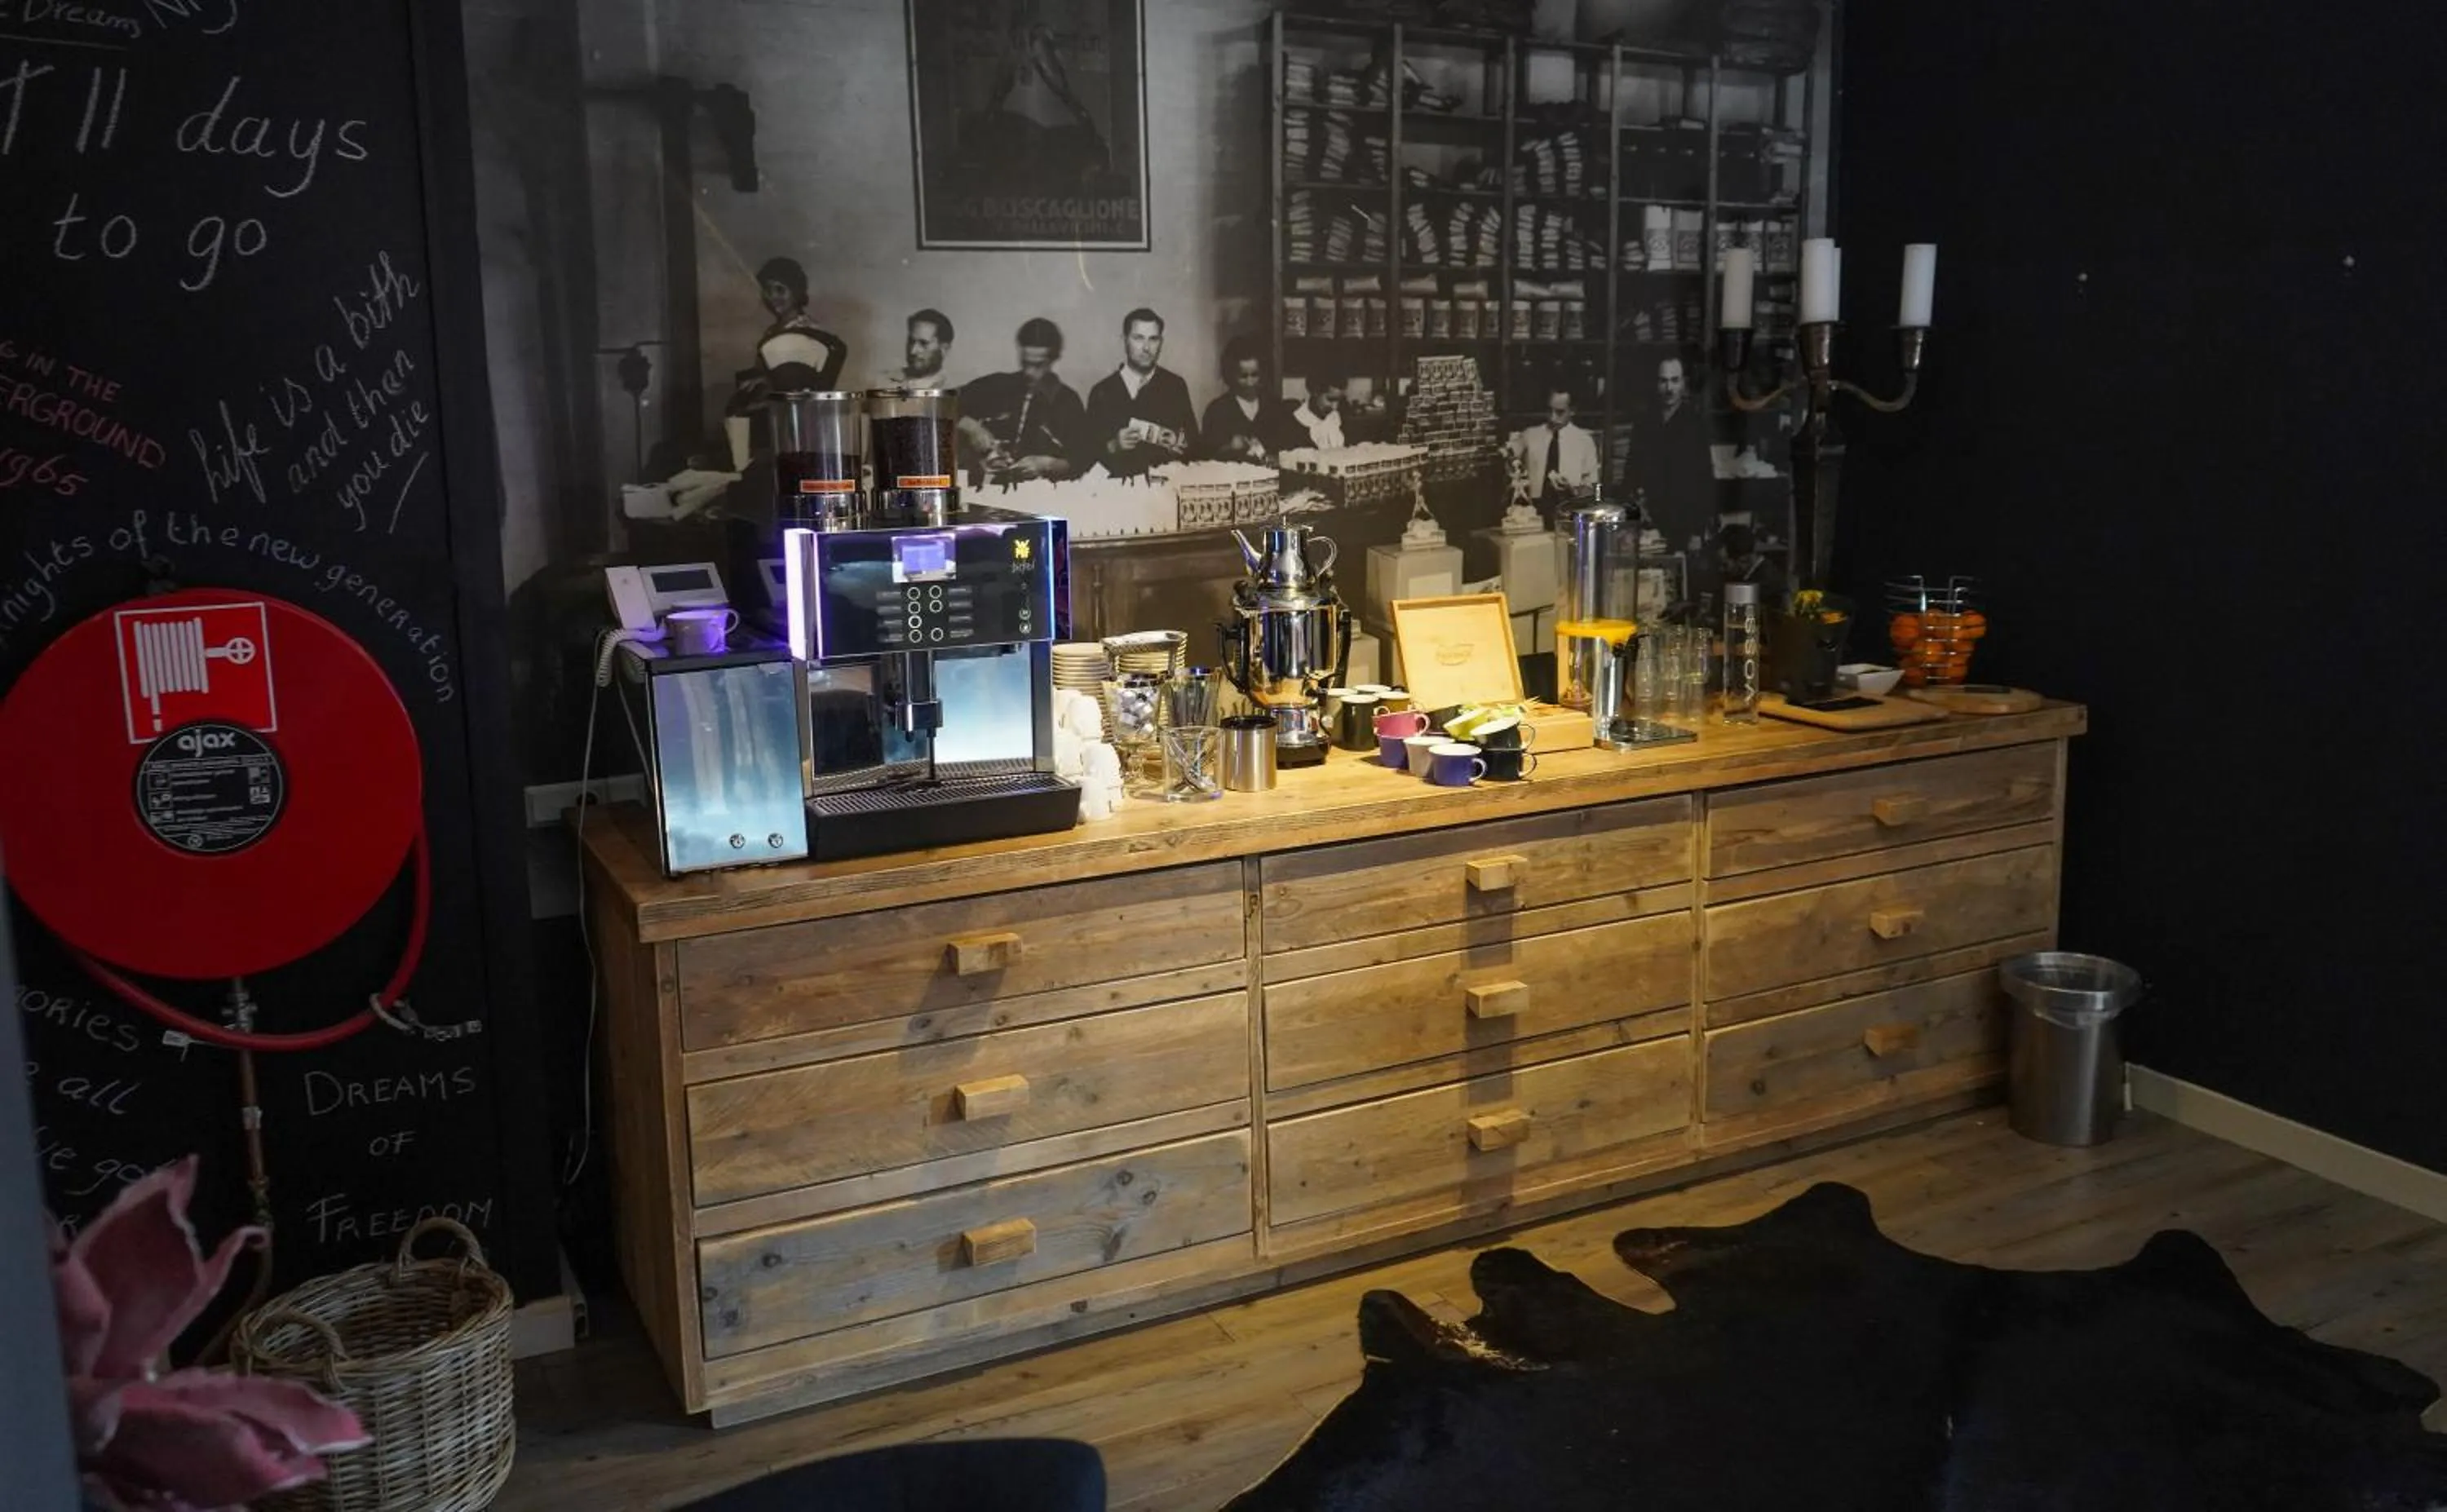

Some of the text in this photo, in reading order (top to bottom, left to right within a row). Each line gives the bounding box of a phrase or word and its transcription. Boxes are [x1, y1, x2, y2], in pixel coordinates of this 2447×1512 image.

[176, 75, 369, 198] days
[53, 192, 268, 292] to go
[25, 351, 57, 377] IN
[67, 365, 123, 403] THE
[259, 378, 313, 428] is
[315, 343, 347, 383] a
[287, 348, 415, 493] and then
[336, 400, 430, 533] you die
[108, 509, 148, 559] of
[166, 510, 241, 547] the
[247, 532, 321, 570] new
[176, 727, 237, 758] ajax
[57, 1077, 142, 1116] all
